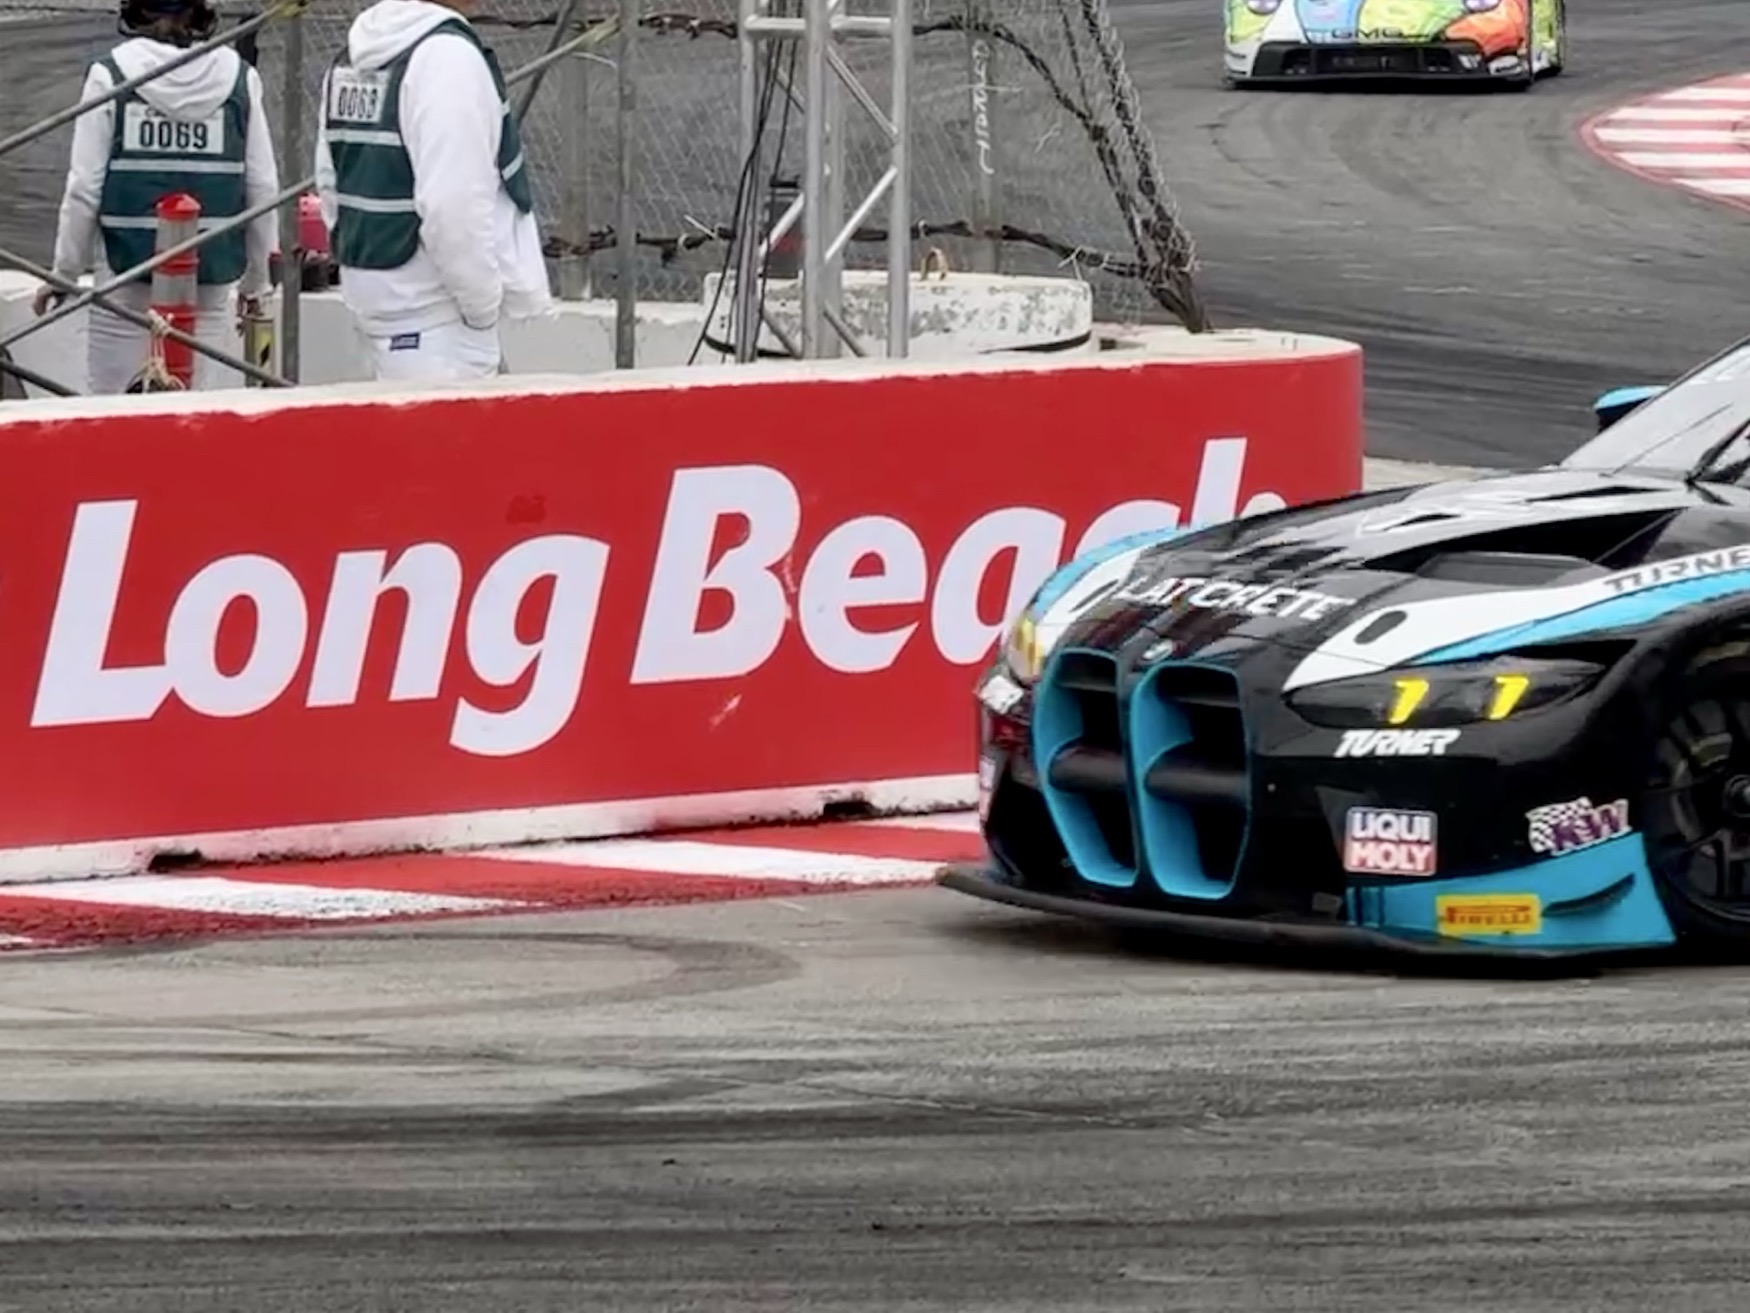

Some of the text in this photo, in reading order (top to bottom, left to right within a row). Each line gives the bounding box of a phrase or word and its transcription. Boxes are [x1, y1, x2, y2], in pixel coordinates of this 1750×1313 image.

[139, 119, 208, 150] 0069
[30, 437, 1288, 756] Long Bea
[1333, 729, 1462, 758] TURNER
[1352, 811, 1432, 840] LIQUI
[1350, 840, 1432, 872] MOLY
